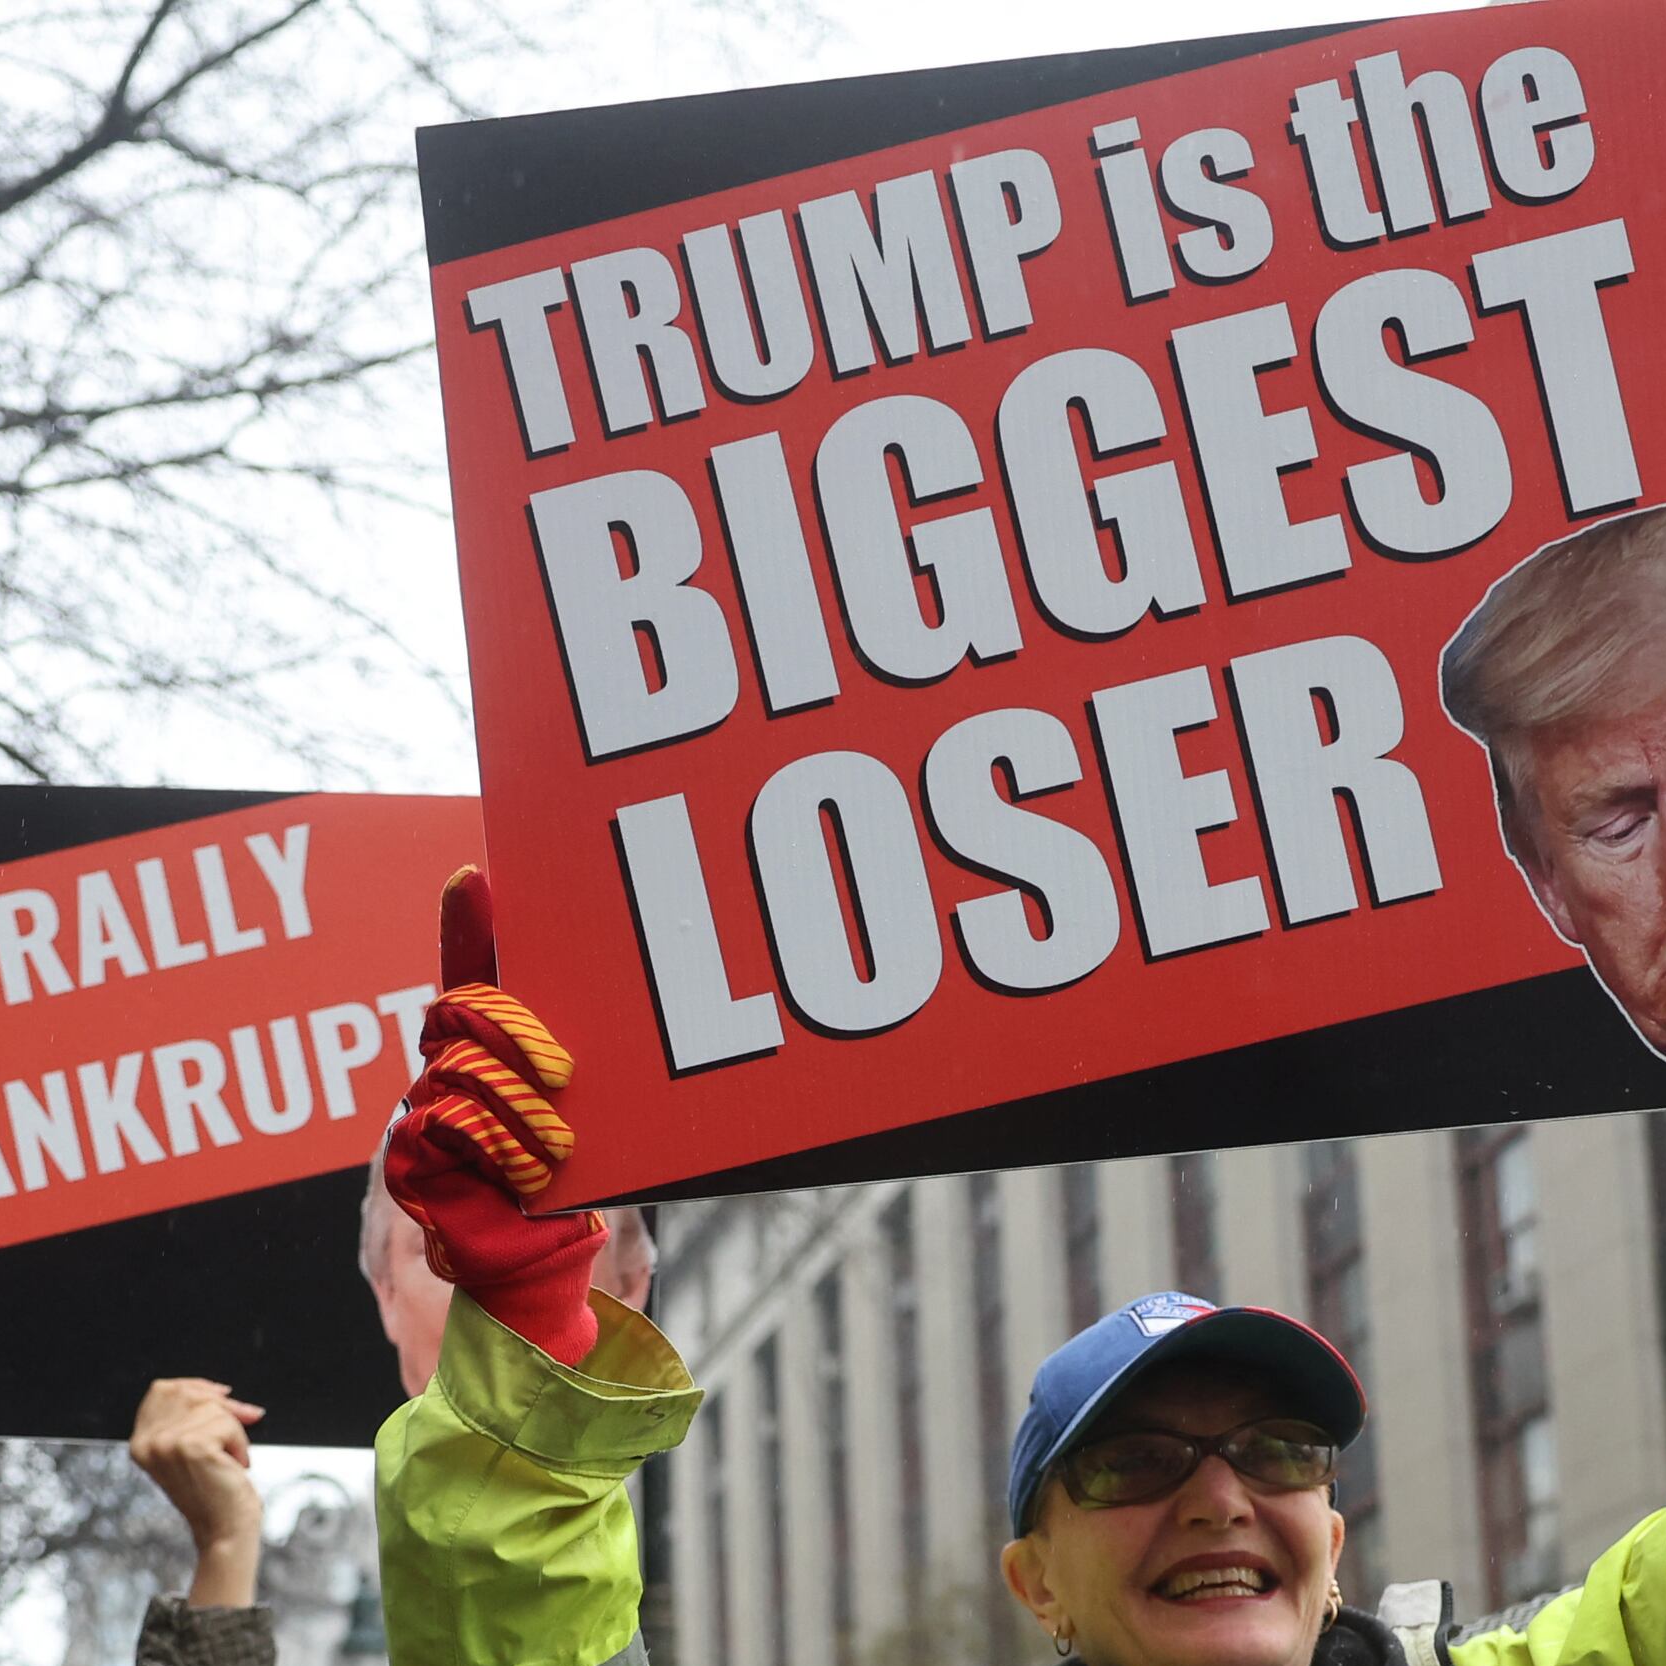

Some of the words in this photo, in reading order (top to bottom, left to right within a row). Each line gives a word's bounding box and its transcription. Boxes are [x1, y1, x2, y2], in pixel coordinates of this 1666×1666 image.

[465, 146, 1063, 456] TRUMP
[1091, 114, 1275, 300] is
[1288, 44, 1596, 246] the
[527, 216, 1645, 760] BIGGEST
[614, 633, 1444, 1074] LOSER
